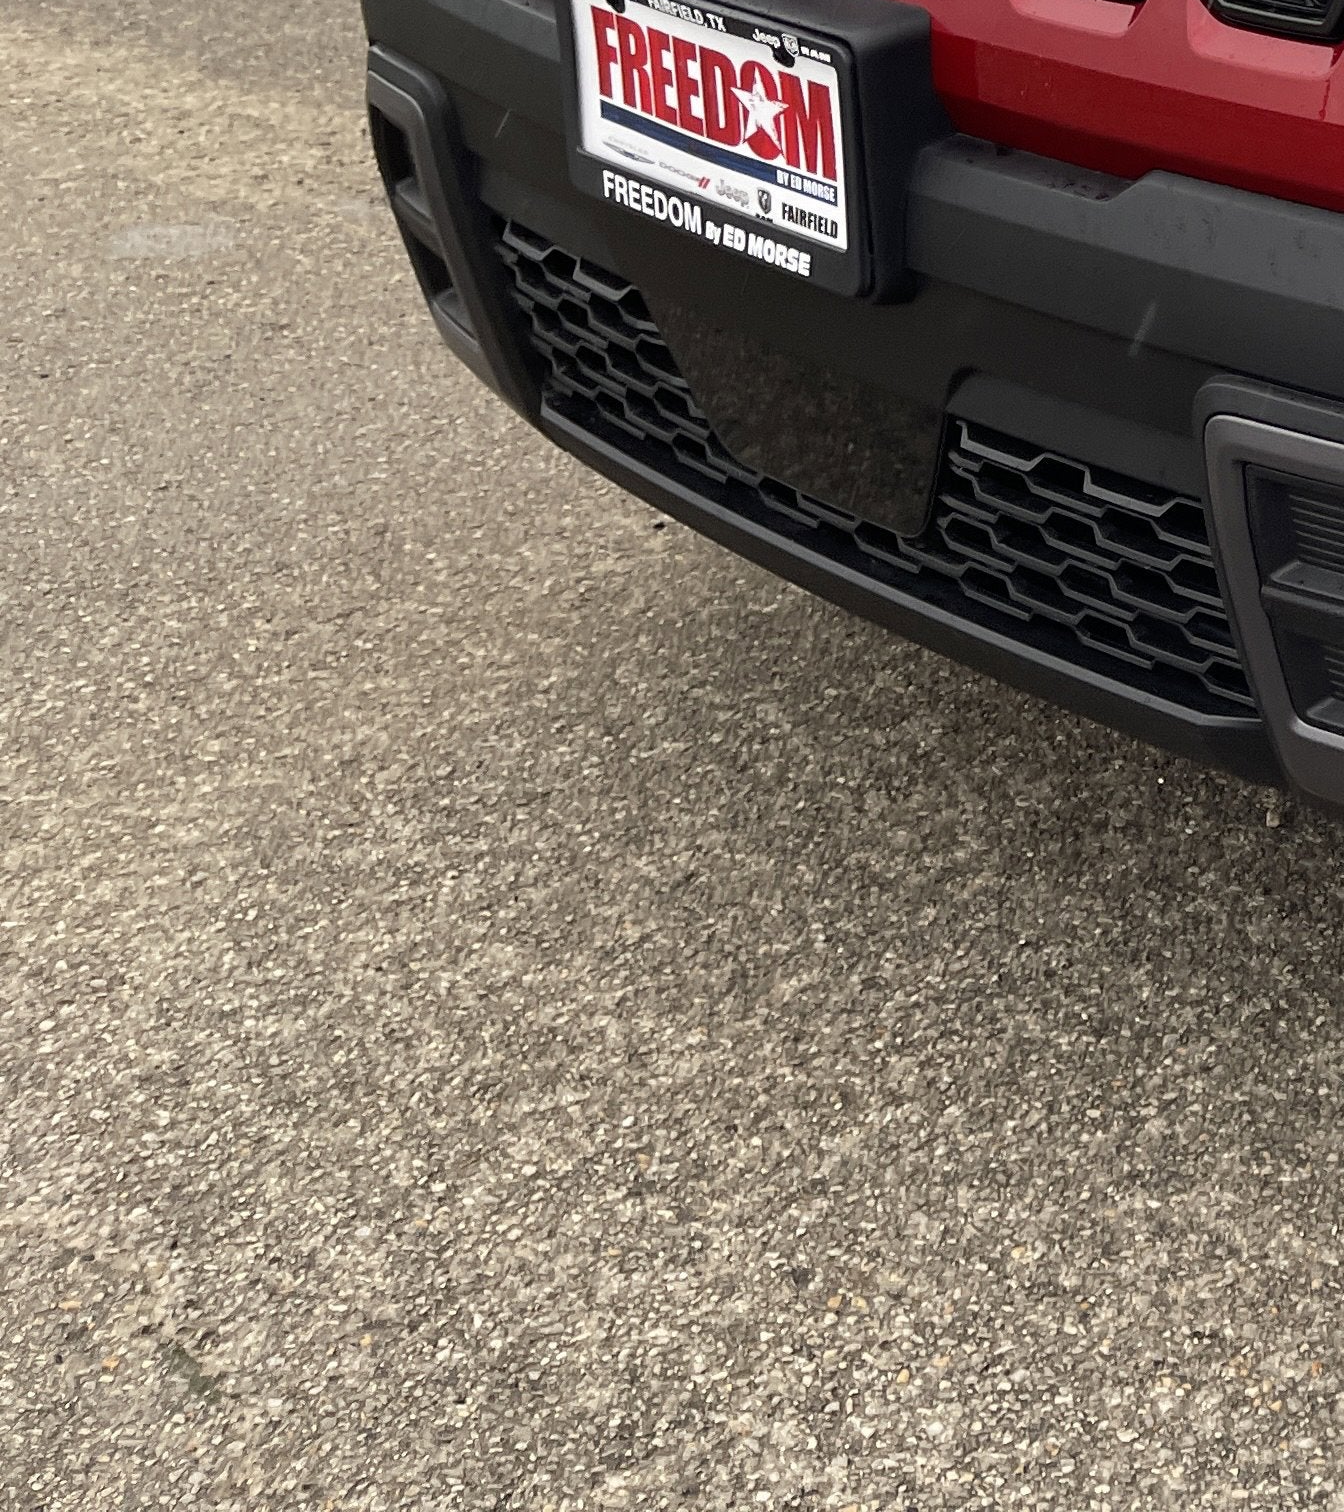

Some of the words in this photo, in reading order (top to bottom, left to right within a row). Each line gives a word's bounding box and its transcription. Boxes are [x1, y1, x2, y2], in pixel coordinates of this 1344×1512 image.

[752, 28, 781, 49] Jeep
[590, 5, 838, 182] FREEDOM
[776, 169, 789, 186] BY
[803, 178, 836, 203] MORSE
[602, 169, 702, 235] FREEDOM
[723, 223, 746, 252] ED
[747, 233, 811, 277] MORSE
[782, 202, 838, 239] FAIRFIELD
